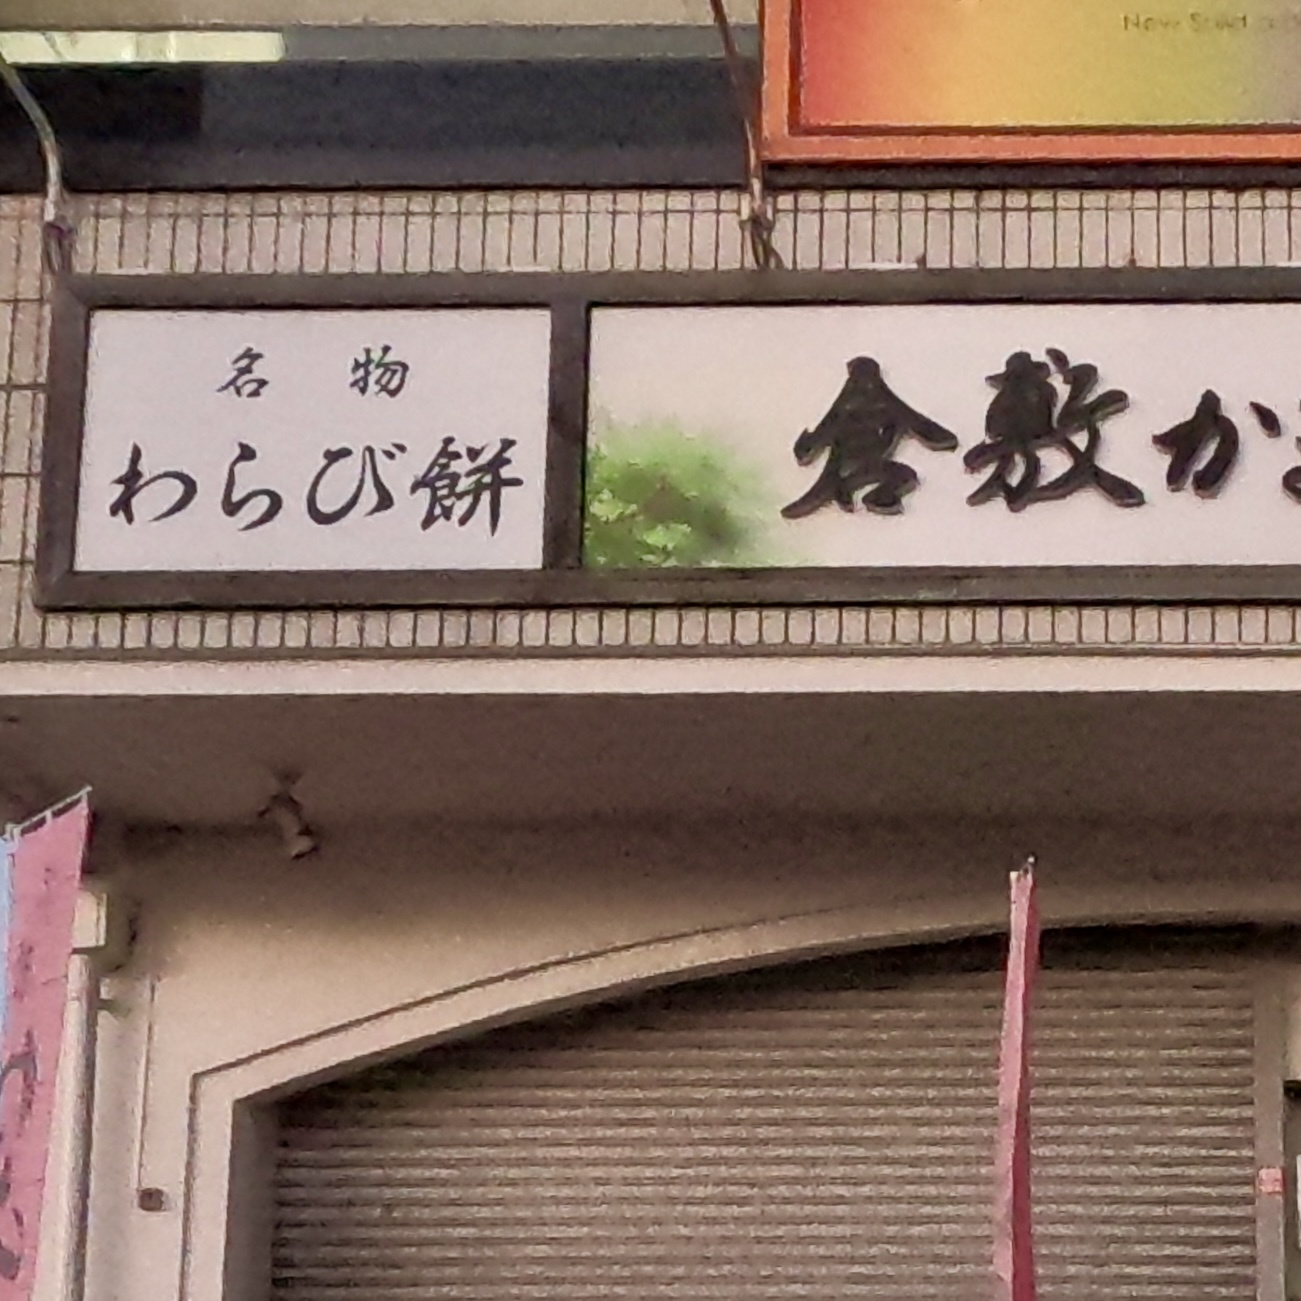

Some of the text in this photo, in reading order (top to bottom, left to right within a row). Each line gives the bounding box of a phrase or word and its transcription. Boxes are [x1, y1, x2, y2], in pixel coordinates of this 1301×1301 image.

[221, 345, 409, 399] 名物
[109, 437, 524, 536] わらび餅
